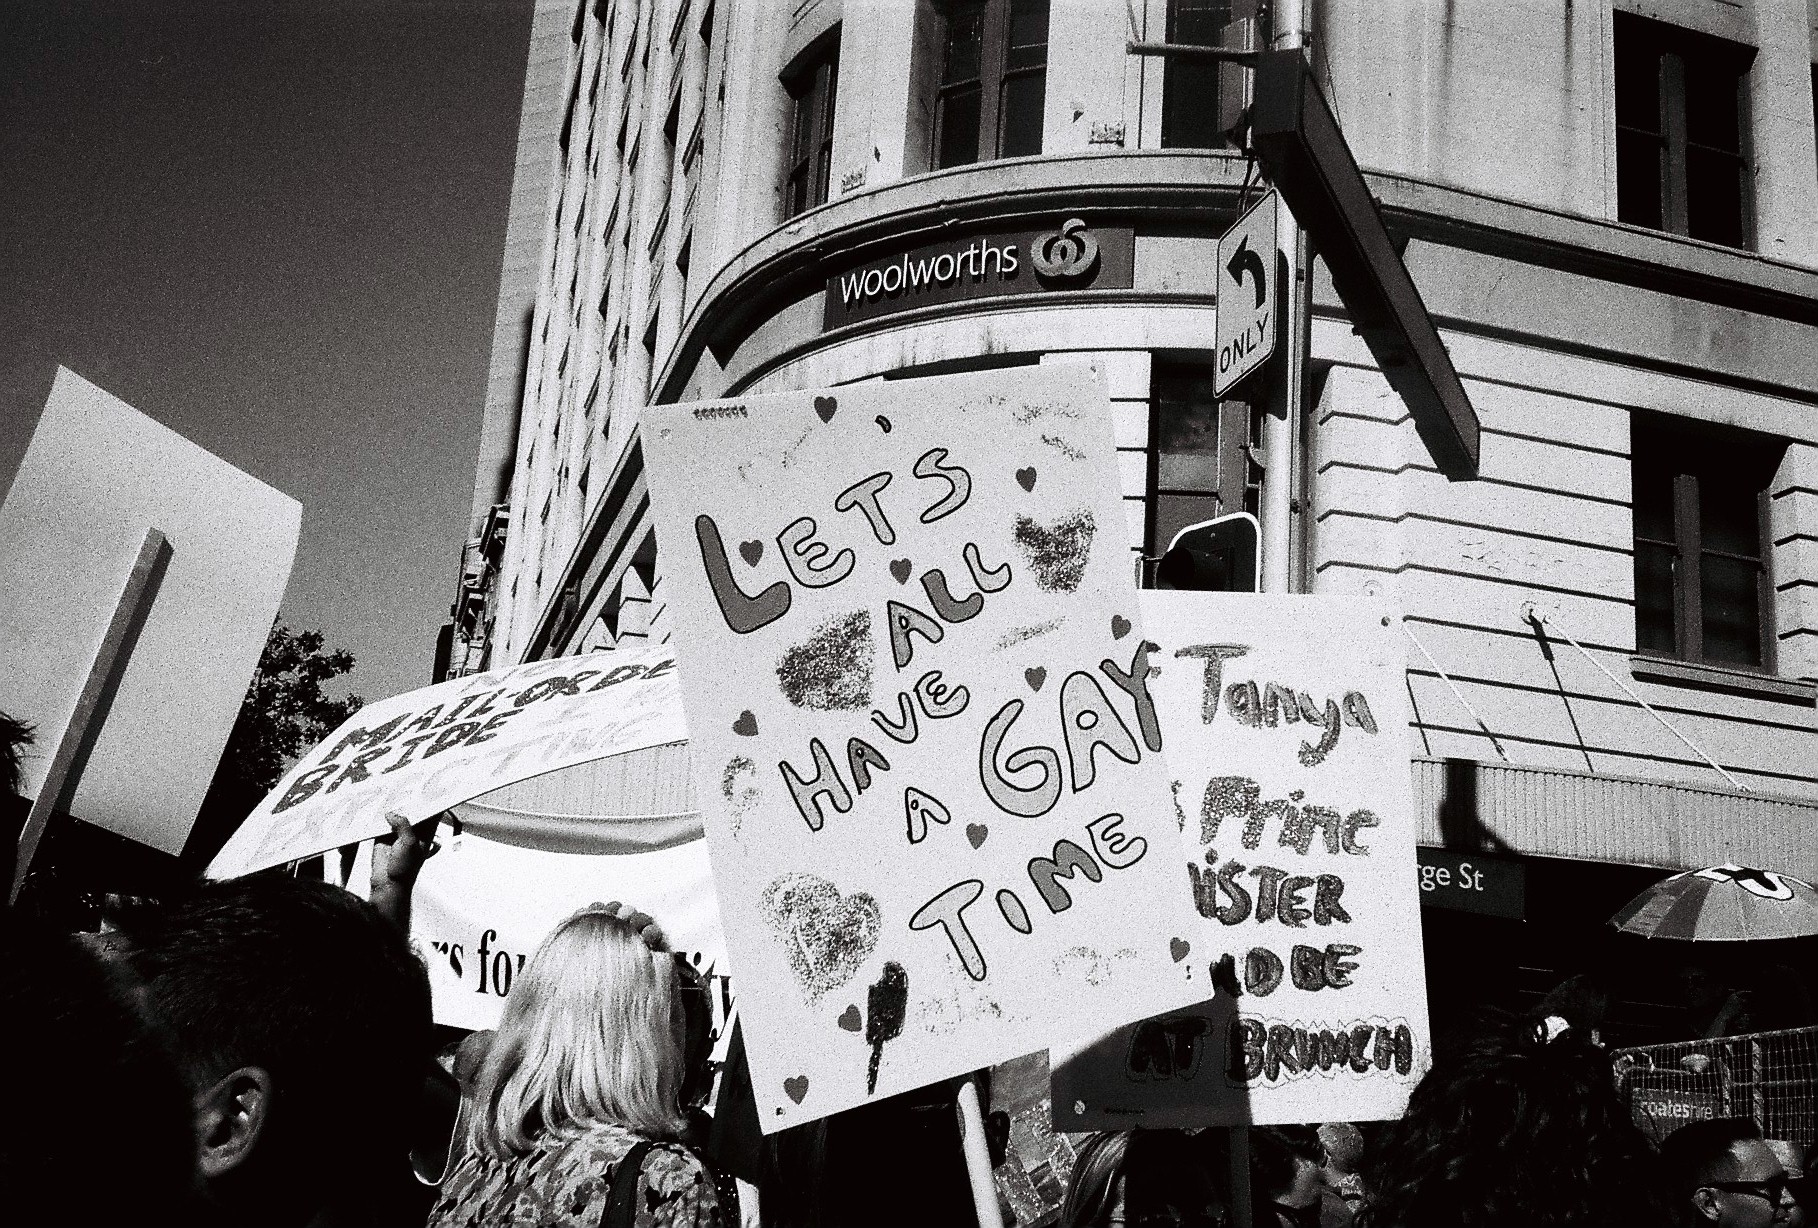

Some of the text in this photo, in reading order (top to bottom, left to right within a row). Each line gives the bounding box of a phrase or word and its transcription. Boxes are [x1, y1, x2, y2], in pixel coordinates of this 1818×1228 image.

[841, 239, 1018, 304] woolworths
[1220, 313, 1270, 374] ONLY
[886, 542, 1012, 672] ALL
[778, 669, 970, 832] HAVE
[904, 786, 952, 845] A
[979, 640, 1163, 818] GAY
[1173, 643, 1379, 767] Tanya
[271, 708, 526, 815] BRIDE
[908, 812, 1148, 982] TIME
[1417, 862, 1484, 892] ge St
[1291, 943, 1362, 993] BE
[1225, 1014, 1416, 1086] BRUNCH
